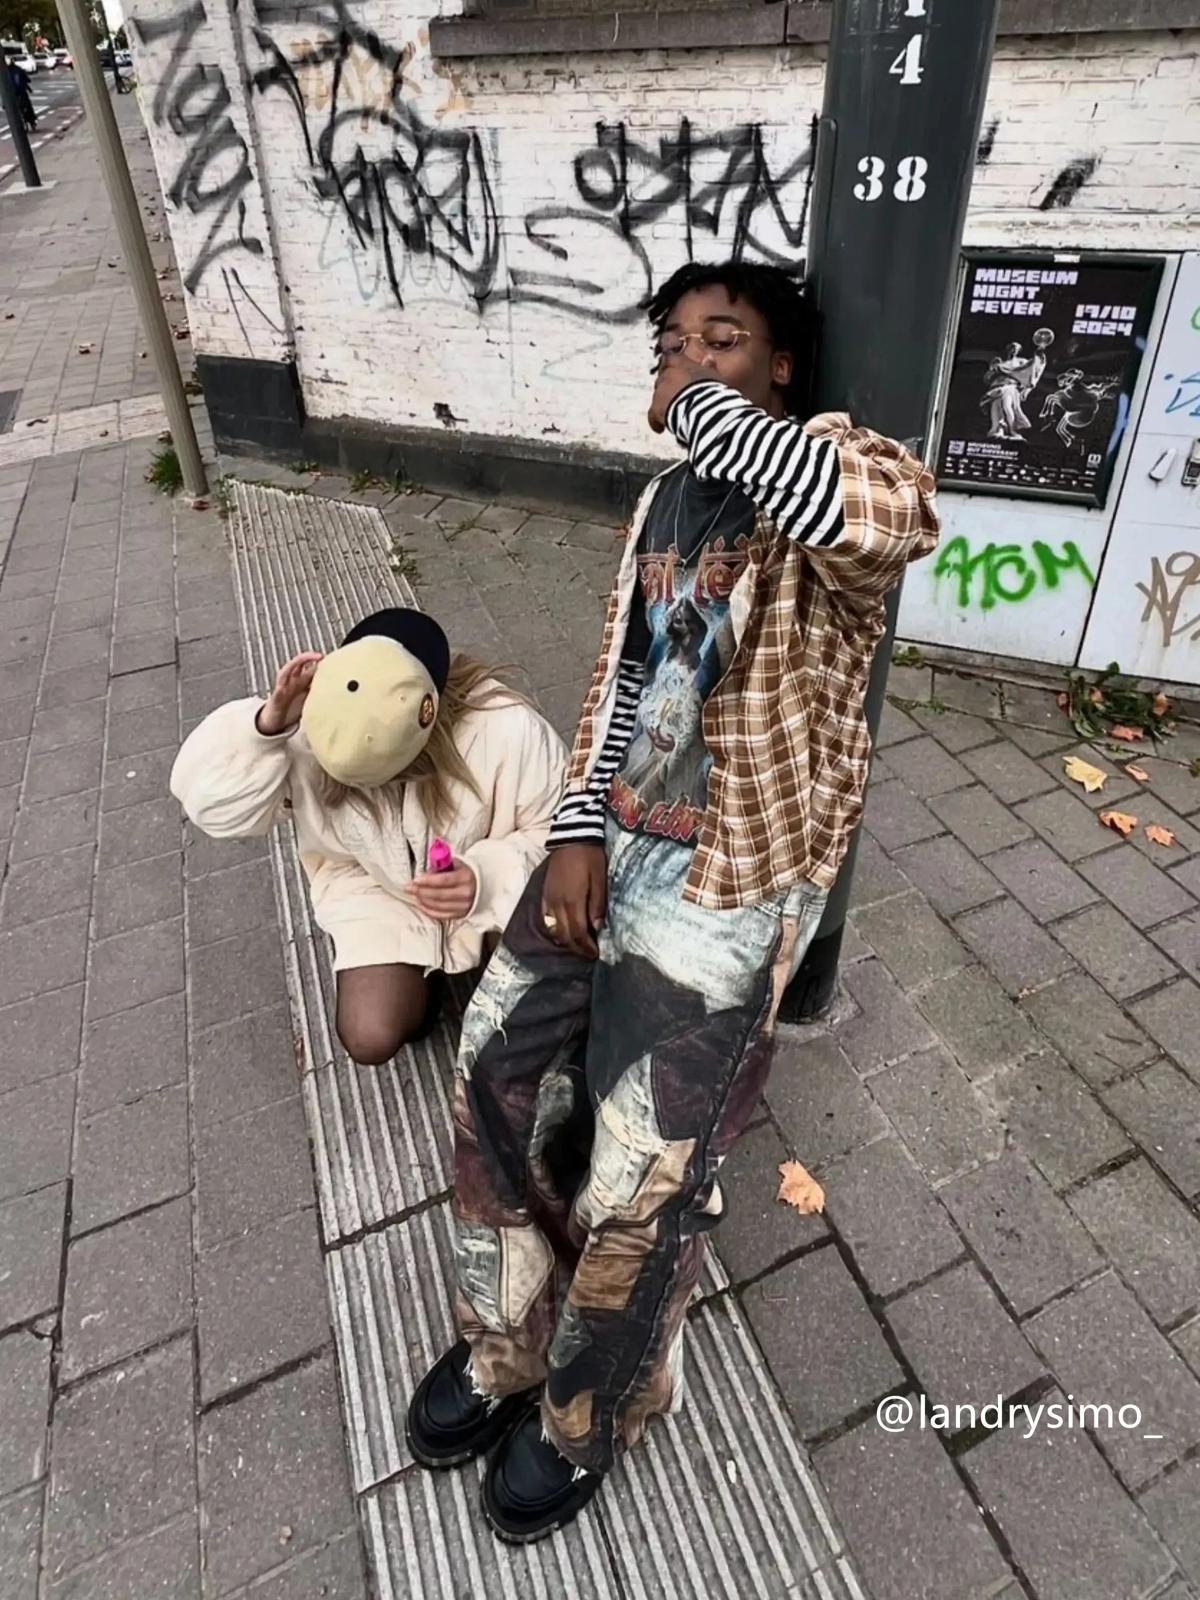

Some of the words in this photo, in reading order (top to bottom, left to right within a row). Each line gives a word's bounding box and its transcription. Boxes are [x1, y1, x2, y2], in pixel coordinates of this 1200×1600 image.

[889, 34, 925, 84] 4
[853, 156, 928, 202] 38
[974, 268, 1079, 285] MUSEUM
[972, 284, 1040, 299] NIGHT
[970, 300, 1044, 316] FEVER
[1074, 304, 1137, 320] 19/10
[1072, 320, 1134, 336] 2024
[934, 535, 1095, 609] ATOM
